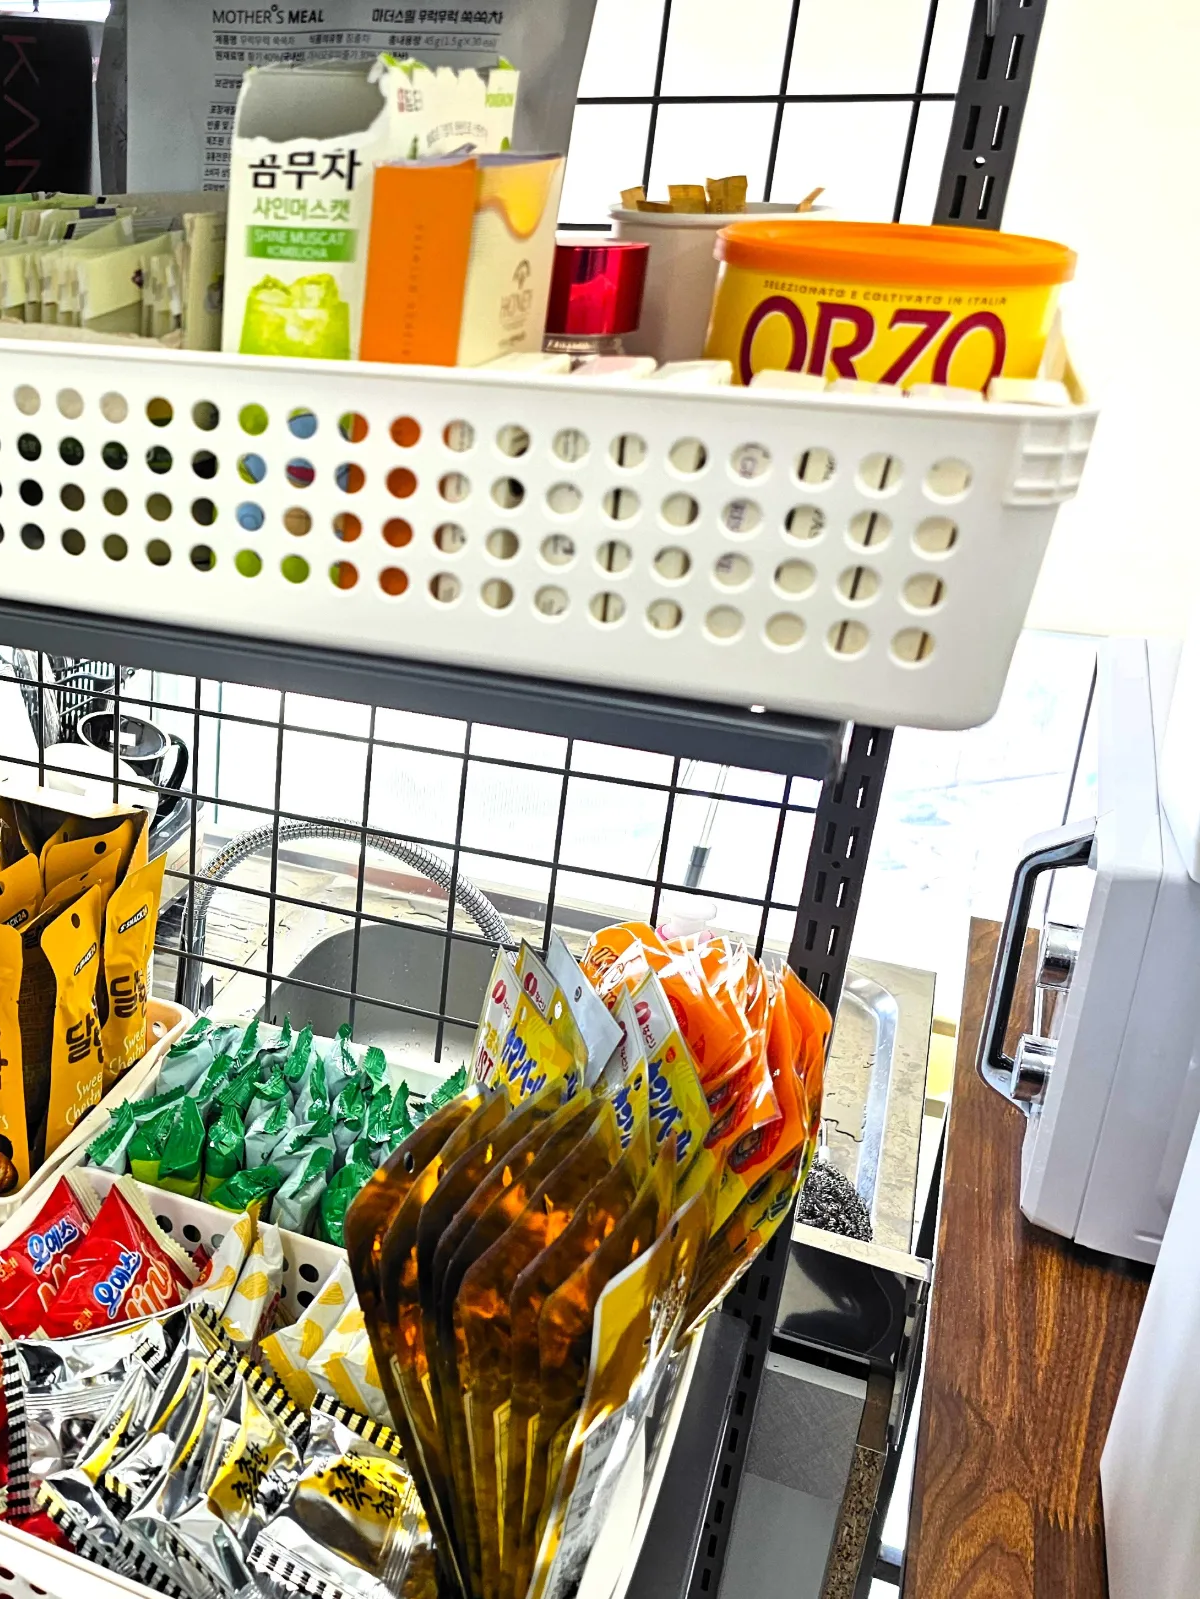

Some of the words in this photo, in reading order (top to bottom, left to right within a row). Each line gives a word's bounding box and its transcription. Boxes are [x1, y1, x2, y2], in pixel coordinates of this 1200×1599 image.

[287, 9, 325, 24] MEAL
[371, 8, 416, 24] 마더스밀
[418, 9, 458, 24] 무럭무럭
[252, 197, 351, 222] 샤인머스캣
[253, 229, 287, 244] SHINE
[289, 230, 345, 244] MUSCAT
[266, 246, 329, 259] KOMBUCHA
[762, 279, 847, 299] SELEZIONATO
[862, 290, 944, 306] COLTIVATO
[947, 295, 965, 306] IN
[966, 295, 1008, 307] ITALIA
[739, 294, 1007, 393] ORZO
[535, 990, 547, 1013] なとり
[641, 1024, 657, 1050] なとり
[619, 1045, 629, 1073] なとり
[26, 1214, 79, 1275] 오예스
[93, 1250, 143, 1319] 오예스
